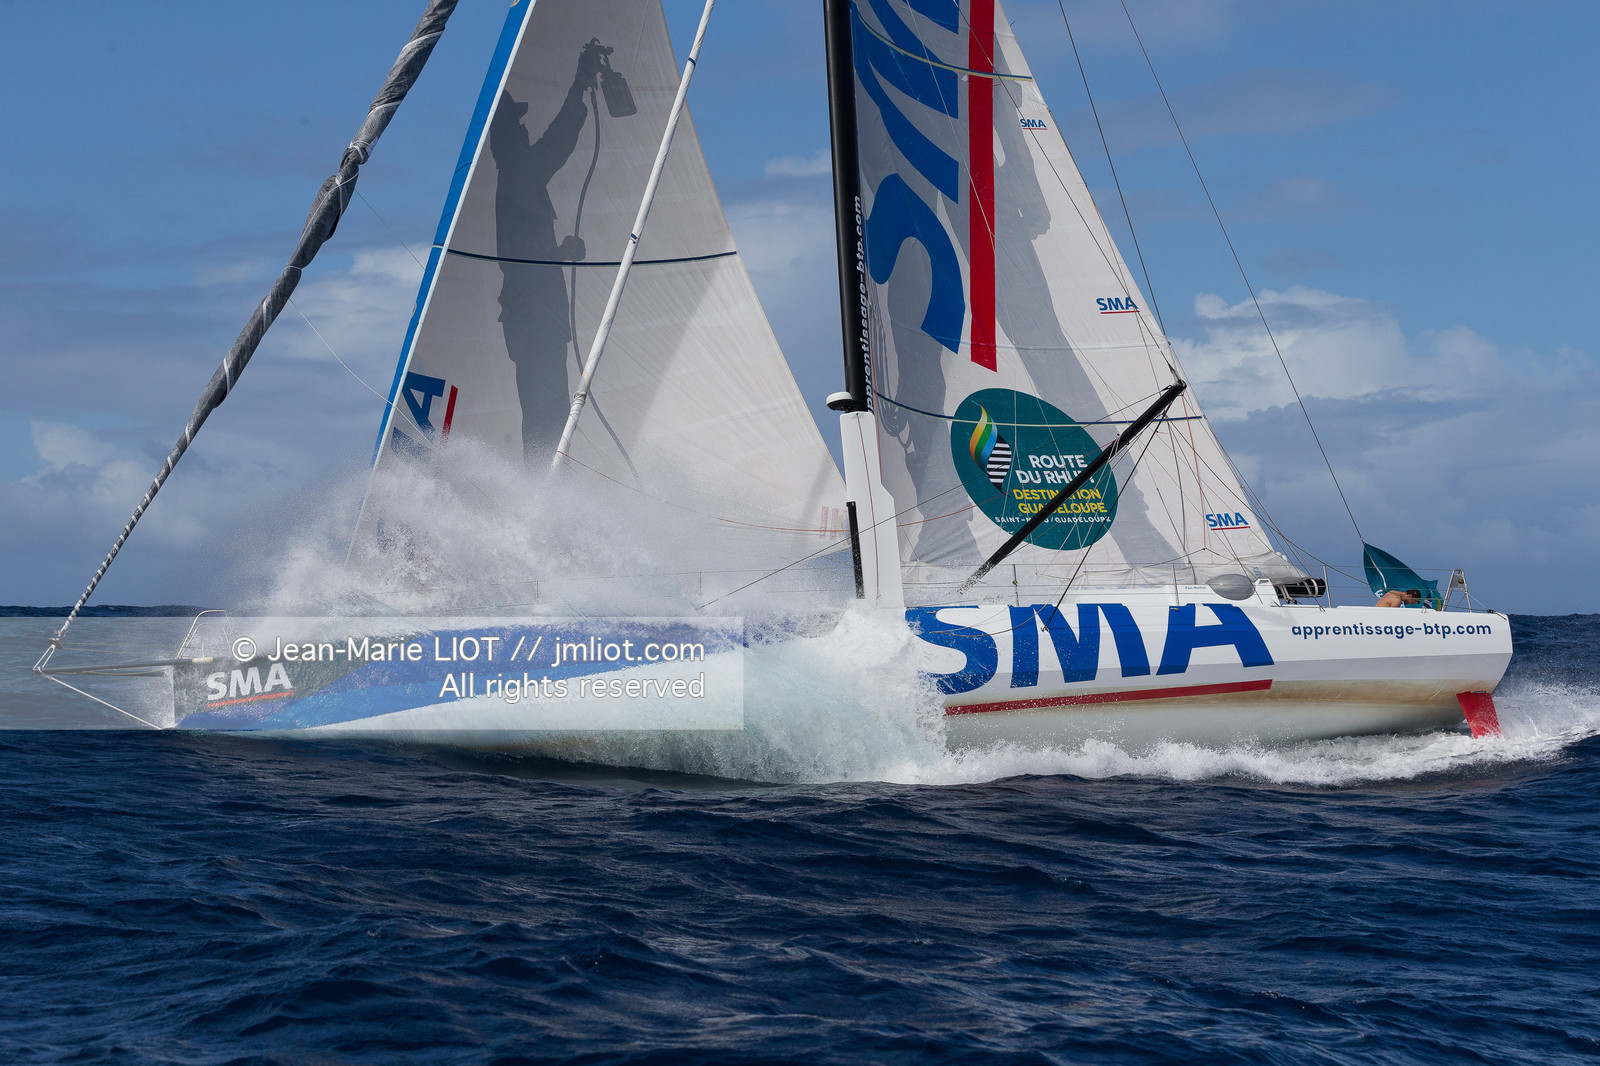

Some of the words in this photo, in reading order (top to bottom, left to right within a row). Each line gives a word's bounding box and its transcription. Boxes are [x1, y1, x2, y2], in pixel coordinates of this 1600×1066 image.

[1020, 118, 1046, 129] SMA
[855, 195, 874, 415] pprentissage-btp.com
[1096, 297, 1138, 311] SMA
[1028, 454, 1088, 469] ROUTE
[1015, 470, 1041, 484] DU
[1013, 488, 1102, 500] DESTINION
[1018, 502, 1108, 514] GUELOUPE
[1205, 512, 1249, 528] SMA
[1291, 622, 1492, 640] apprentissage-btp.com
[904, 602, 1275, 695] SMA
[206, 662, 293, 701] SMA
